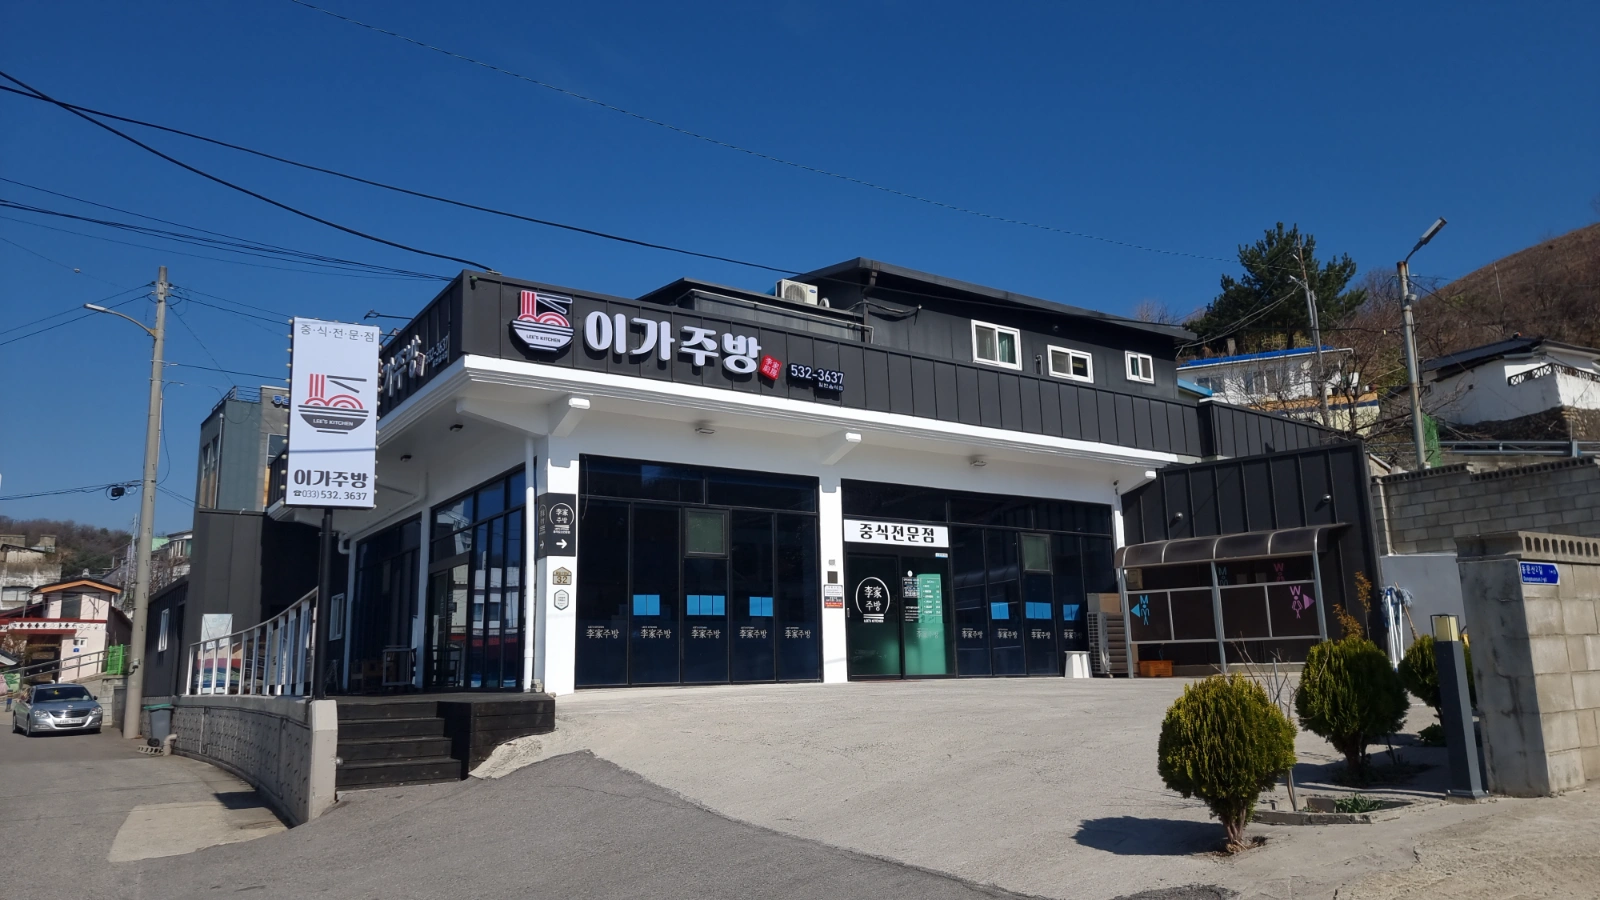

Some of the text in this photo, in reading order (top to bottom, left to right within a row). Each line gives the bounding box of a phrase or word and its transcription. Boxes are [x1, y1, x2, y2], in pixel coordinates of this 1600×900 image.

[583, 310, 762, 375] 이가주방
[790, 364, 844, 385] 532-3637
[293, 469, 369, 489] 이가주방
[859, 523, 935, 544] 중식전문점
[557, 576, 568, 584] 32
[864, 585, 882, 599] 李家
[1290, 586, 1301, 595] W
[1140, 595, 1149, 604] M
[865, 600, 882, 612] 주방
[586, 629, 619, 639] 李家주방
[641, 629, 672, 639] 李家주방
[691, 629, 721, 639] 李家주방
[739, 629, 768, 639] 李家주방
[785, 630, 812, 639] 李家주방
